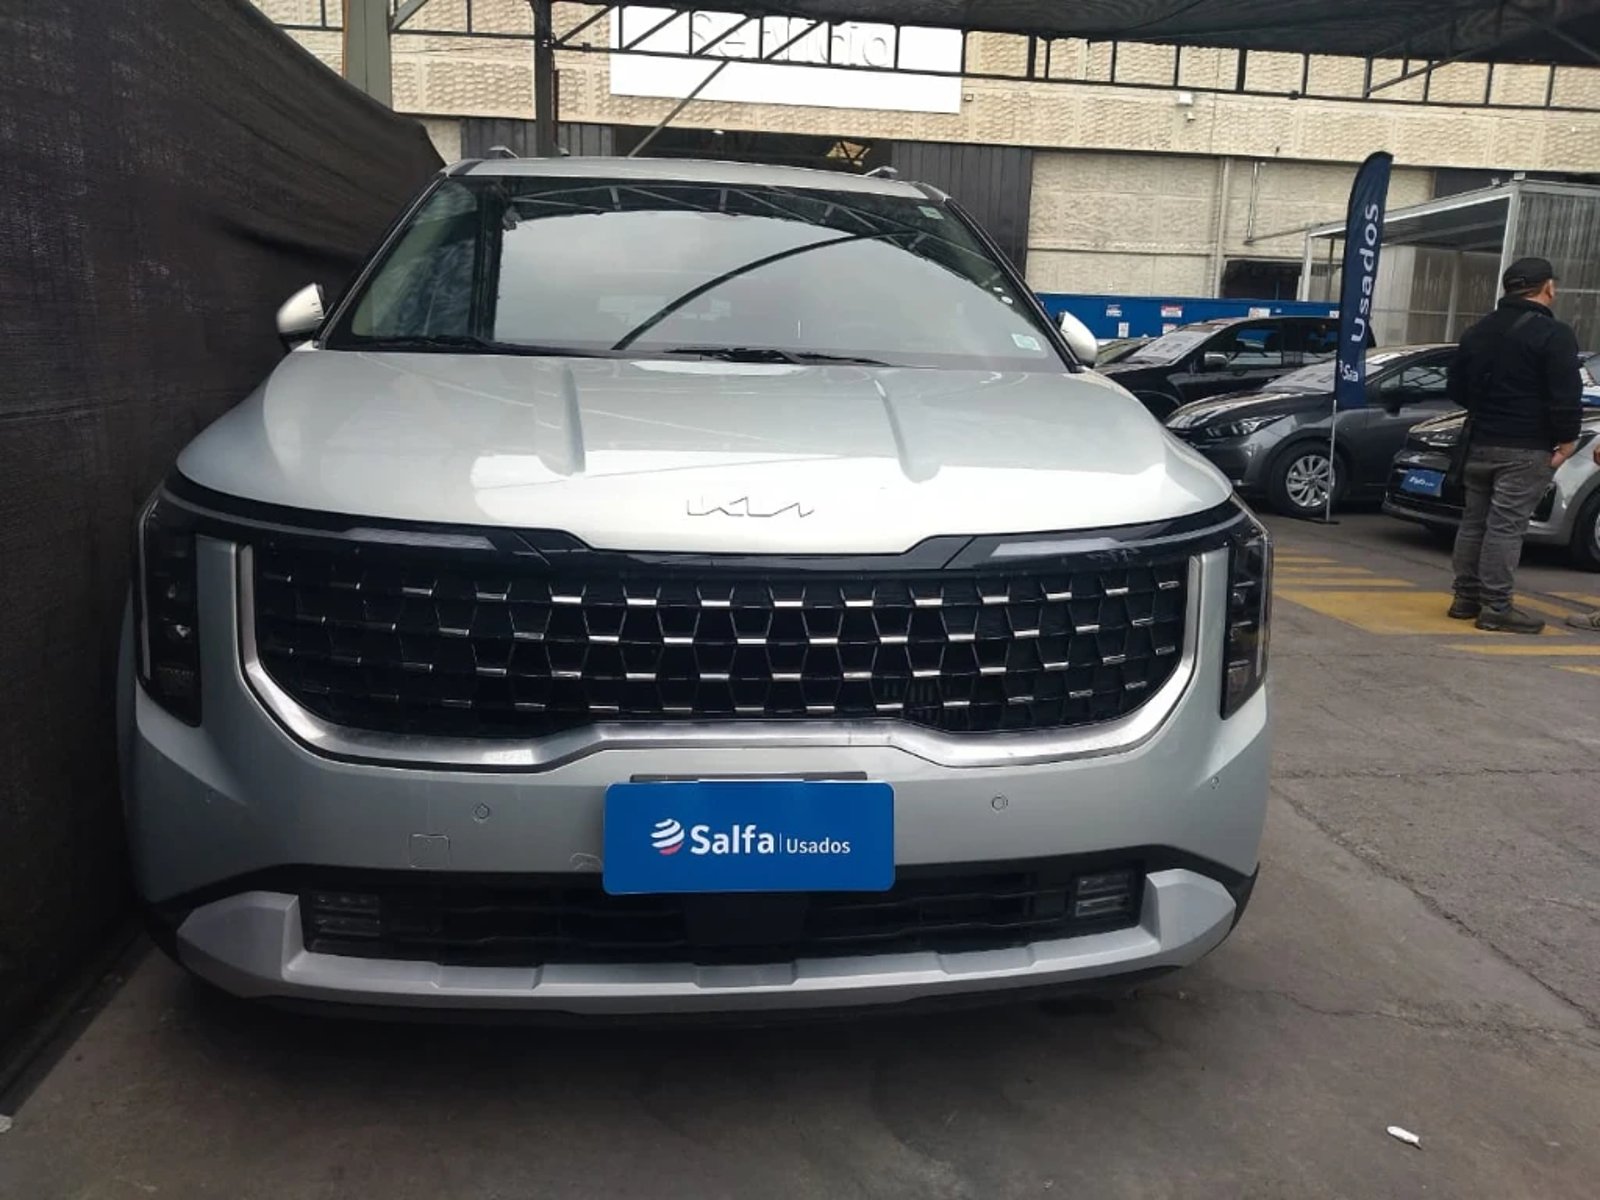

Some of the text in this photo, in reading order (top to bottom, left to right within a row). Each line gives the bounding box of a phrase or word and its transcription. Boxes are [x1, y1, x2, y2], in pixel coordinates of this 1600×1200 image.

[1351, 202, 1379, 342] Usados
[690, 824, 851, 855] Salfa Usados
